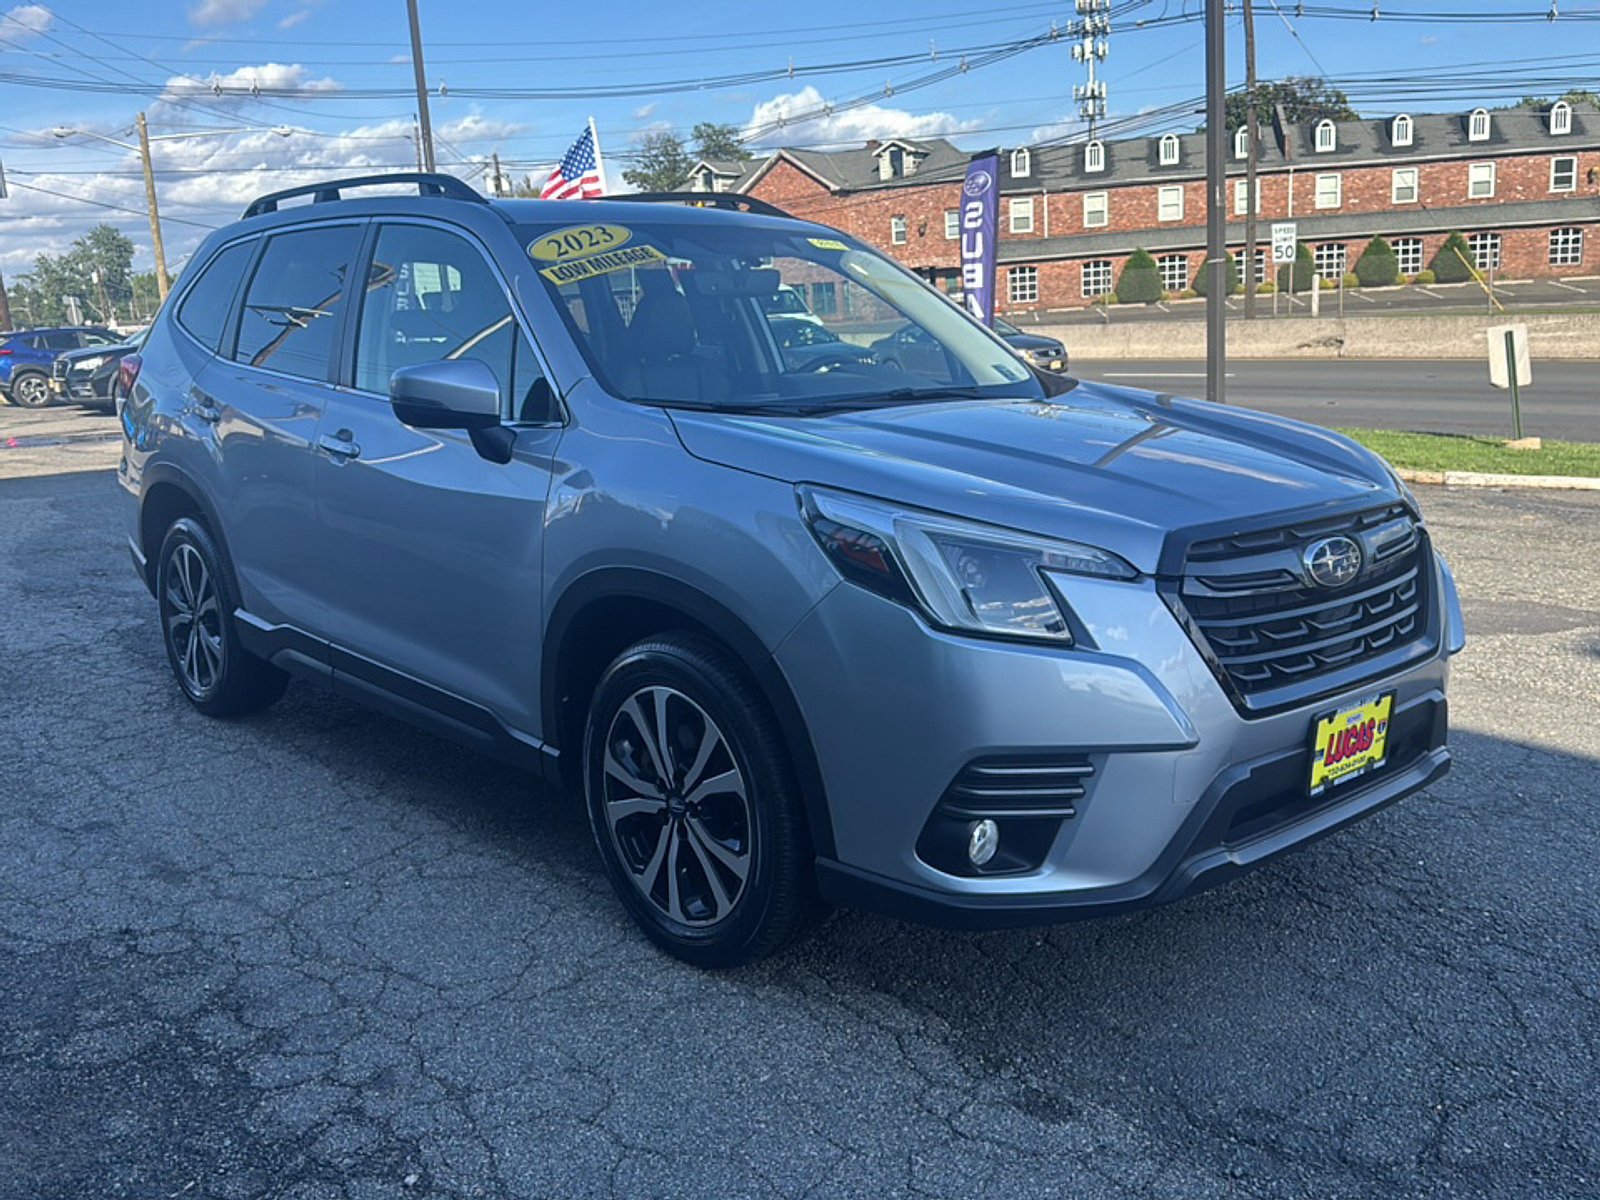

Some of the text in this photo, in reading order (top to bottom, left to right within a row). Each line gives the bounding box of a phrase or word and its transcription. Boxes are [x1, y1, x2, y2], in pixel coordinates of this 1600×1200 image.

[546, 226, 614, 257] 2023
[1274, 226, 1295, 234] SPEED
[550, 246, 657, 281] LOW MILEAGE
[1275, 244, 1294, 259] 50
[1324, 716, 1376, 767] LUCAS
